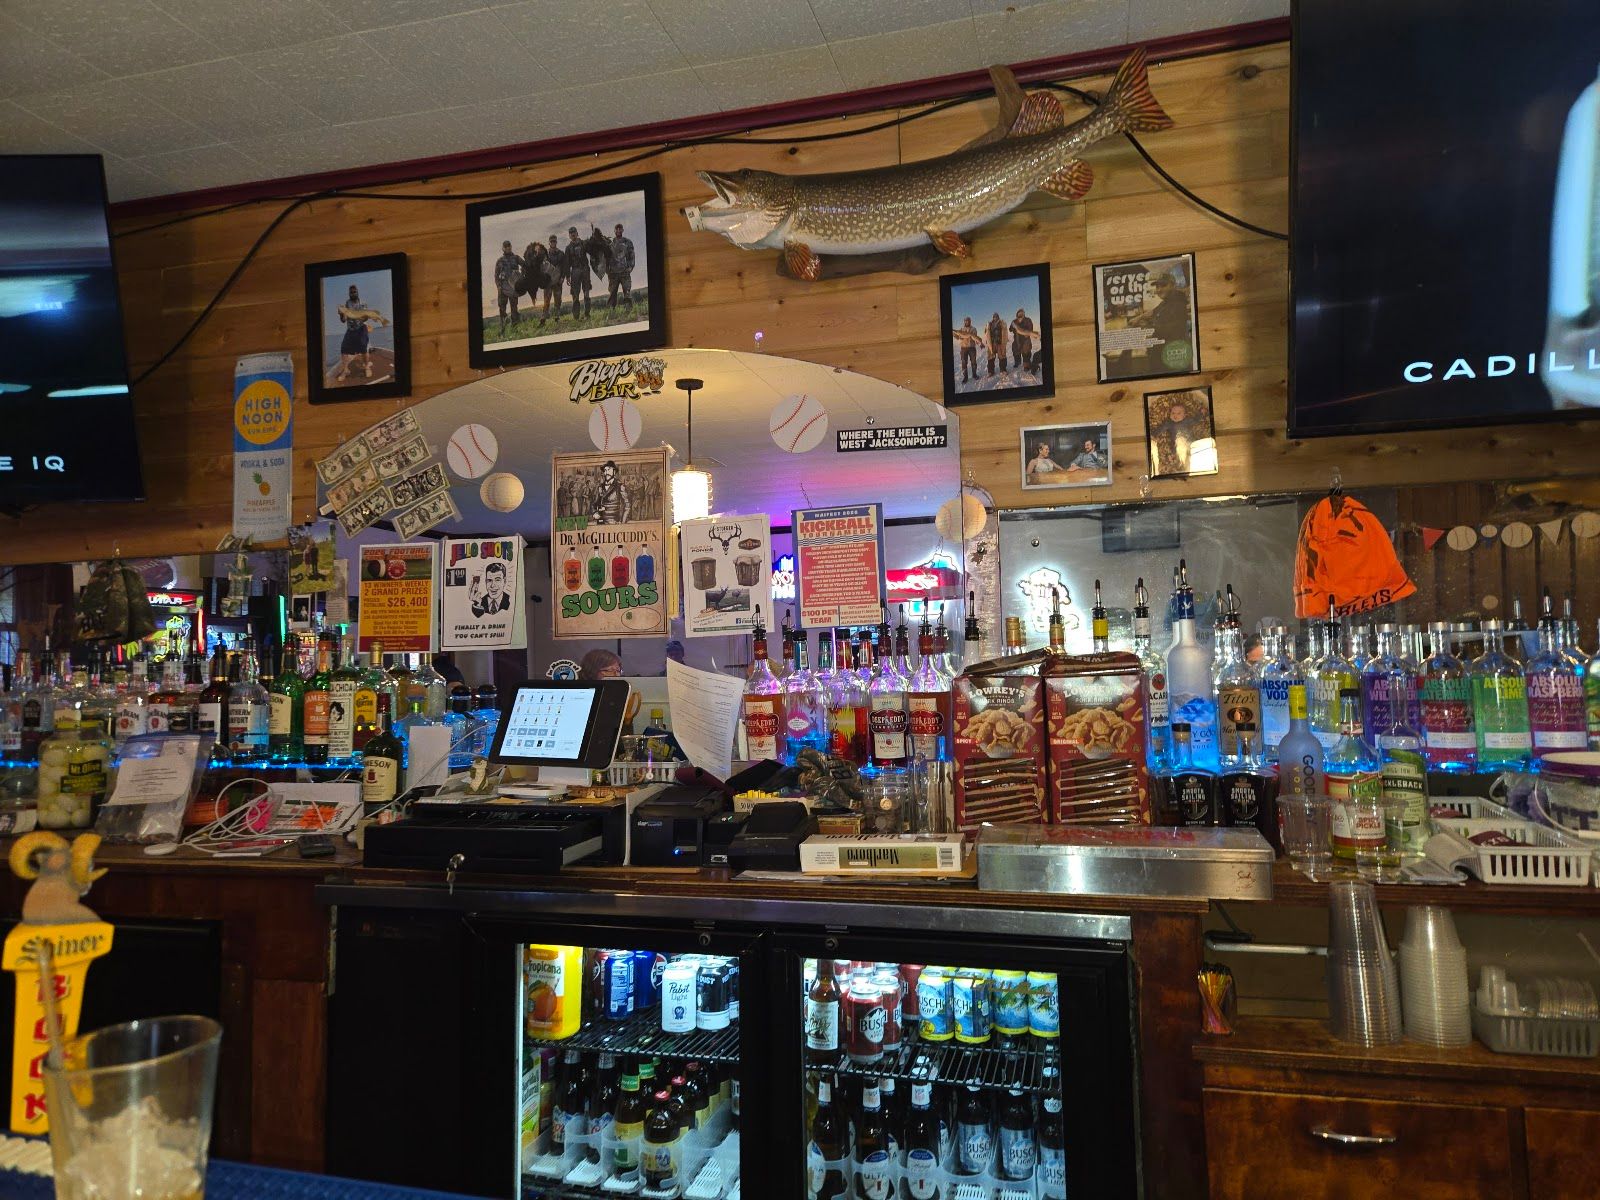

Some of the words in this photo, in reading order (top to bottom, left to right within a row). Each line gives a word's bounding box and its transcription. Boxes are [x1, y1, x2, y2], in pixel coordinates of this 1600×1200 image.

[1111, 294, 1145, 305] wee
[570, 359, 633, 402] Bley's
[245, 397, 281, 411] HIGH
[242, 411, 282, 425] NOON
[840, 430, 873, 441] WHERE
[876, 428, 896, 438] THE
[898, 428, 923, 438] HELL
[925, 427, 936, 436] IS
[840, 440, 867, 449] WEST
[869, 436, 945, 448] JACKSONPORT?
[33, 456, 65, 472] IQ
[800, 517, 873, 533] KICKBALL
[803, 529, 872, 540] TOURNAMENT
[480, 541, 514, 562] SHOTS
[402, 587, 428, 595] PRIZES
[561, 581, 659, 619] SOURS
[822, 607, 838, 615] PER
[810, 617, 832, 625] TEAM
[304, 695, 328, 704] JAMES
[968, 686, 1026, 700] LOWREY'S
[1223, 692, 1256, 705] Tito's
[1266, 690, 1289, 701] VOD
[1231, 794, 1256, 802] SAILING
[847, 848, 899, 867] Marlboro
[15, 933, 106, 967] Shiner
[528, 960, 562, 975] Tropicana
[669, 981, 690, 995] Pabst
